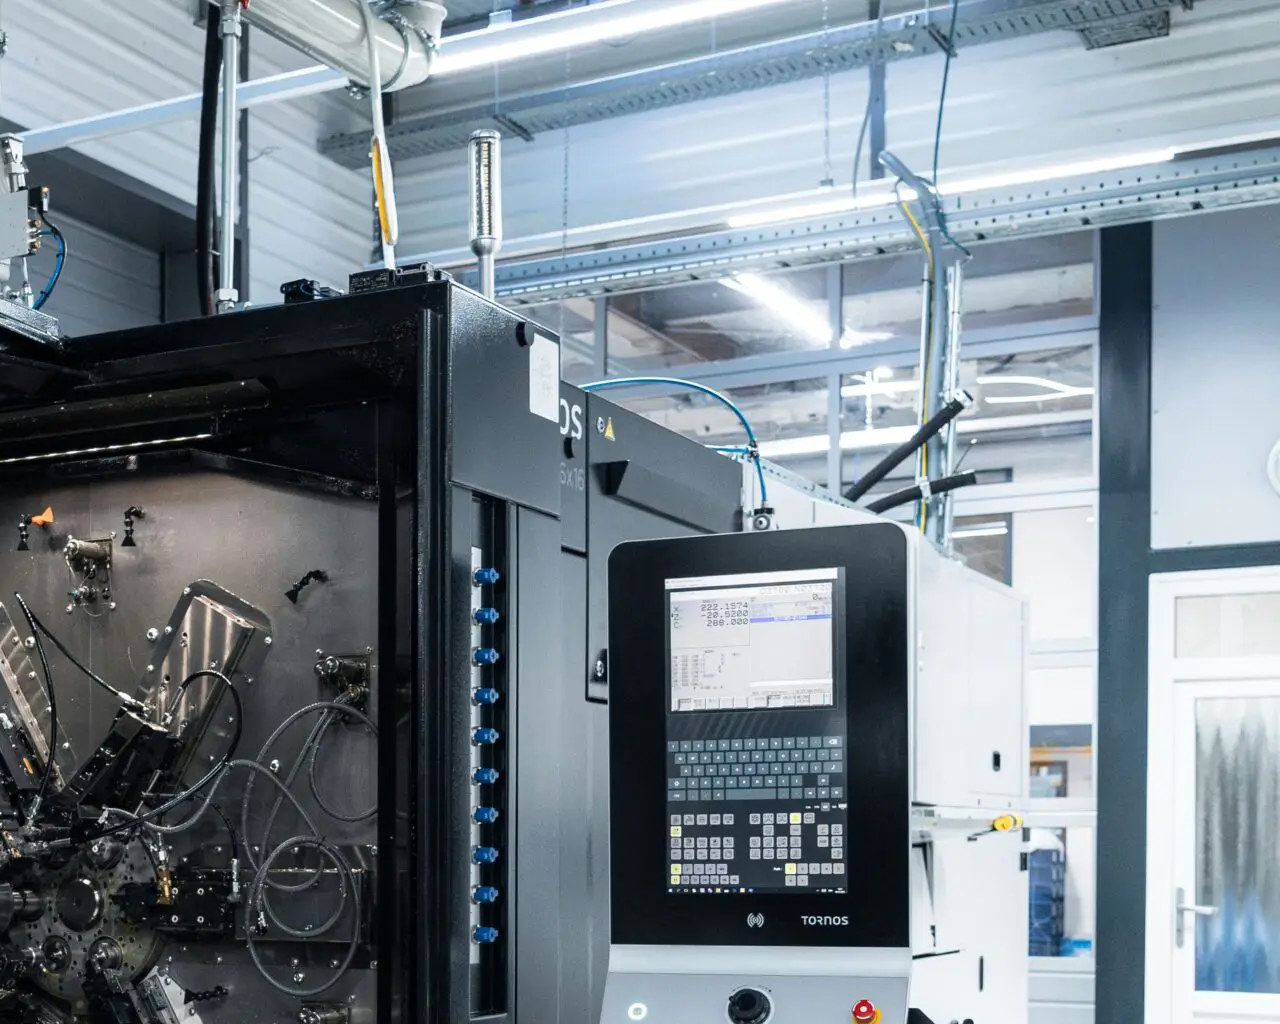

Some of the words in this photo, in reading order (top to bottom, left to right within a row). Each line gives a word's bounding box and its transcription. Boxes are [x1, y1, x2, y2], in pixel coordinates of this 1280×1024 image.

[701, 602, 748, 612] 222.1574
[701, 610, 748, 619] -20.5200
[800, 915, 849, 926] TORNOS
